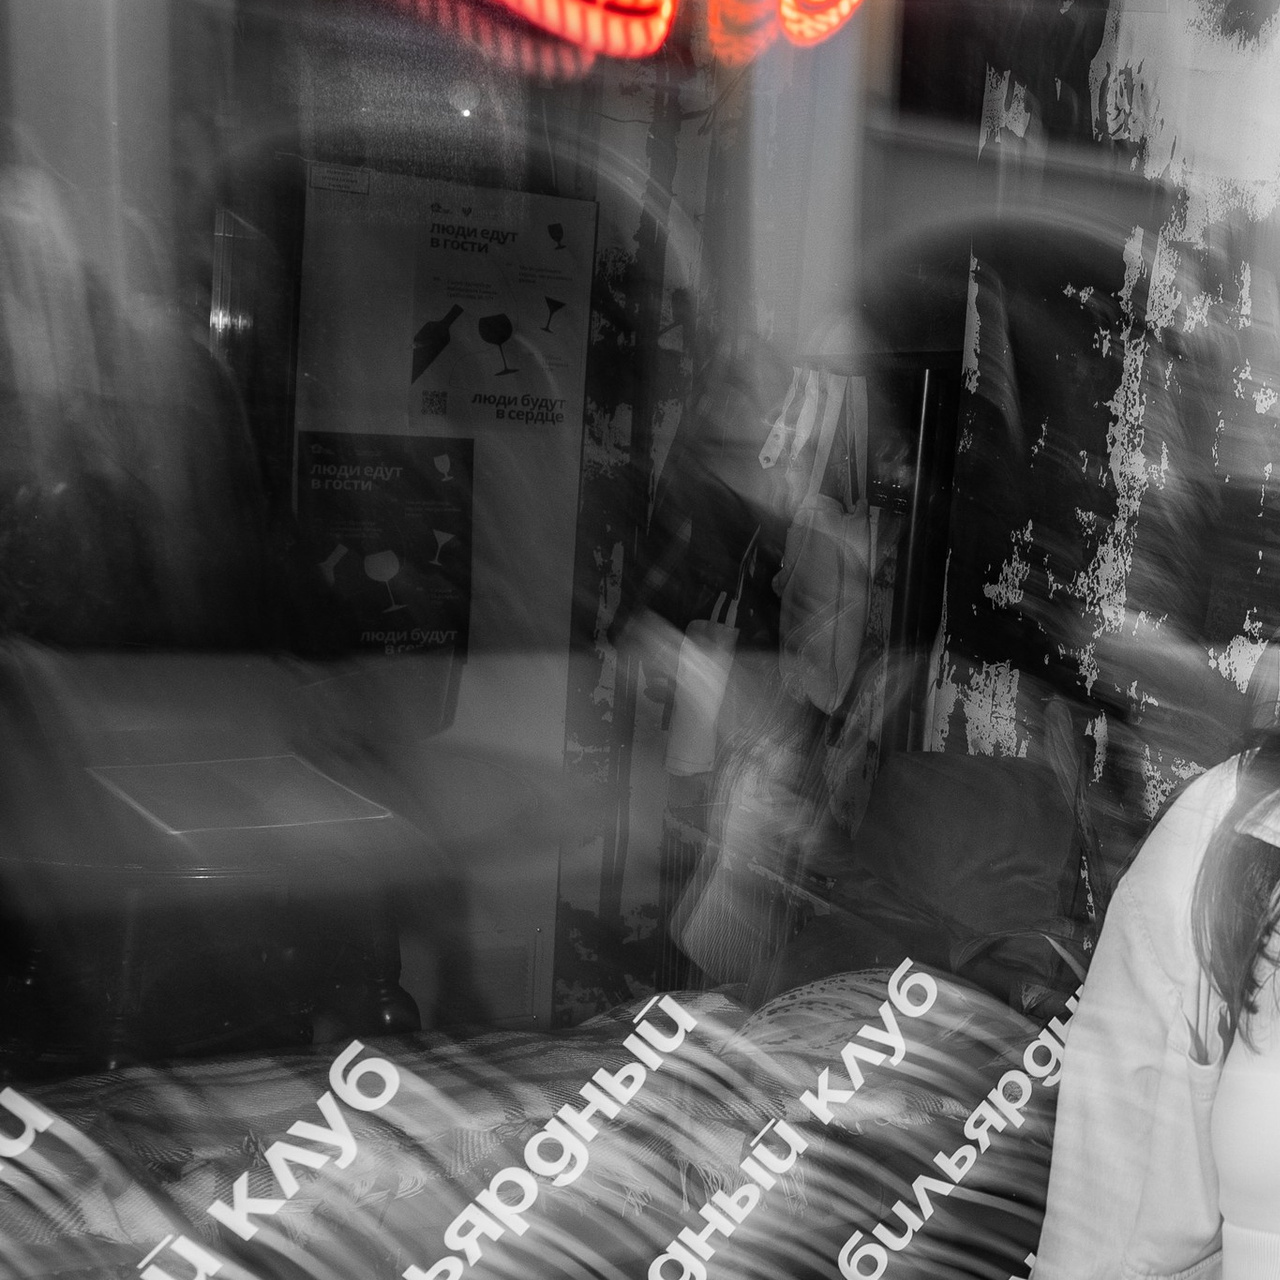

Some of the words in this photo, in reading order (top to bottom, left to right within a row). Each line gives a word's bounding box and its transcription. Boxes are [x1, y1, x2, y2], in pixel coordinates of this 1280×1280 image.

[430, 222, 478, 240] люди
[480, 228, 518, 245] едут
[430, 237, 440, 249] в
[443, 238, 489, 253] гости
[472, 393, 518, 407] люди
[521, 394, 566, 411] будут
[496, 409, 505, 419] в
[508, 410, 564, 425] сердце
[310, 463, 360, 479] люди
[363, 465, 403, 481] едут
[311, 479, 321, 490] в
[324, 479, 373, 492] гости
[360, 629, 408, 644] люди
[410, 628, 458, 644] будут
[800, 957, 938, 1124] клуб
[207, 1039, 400, 1241] клуб
